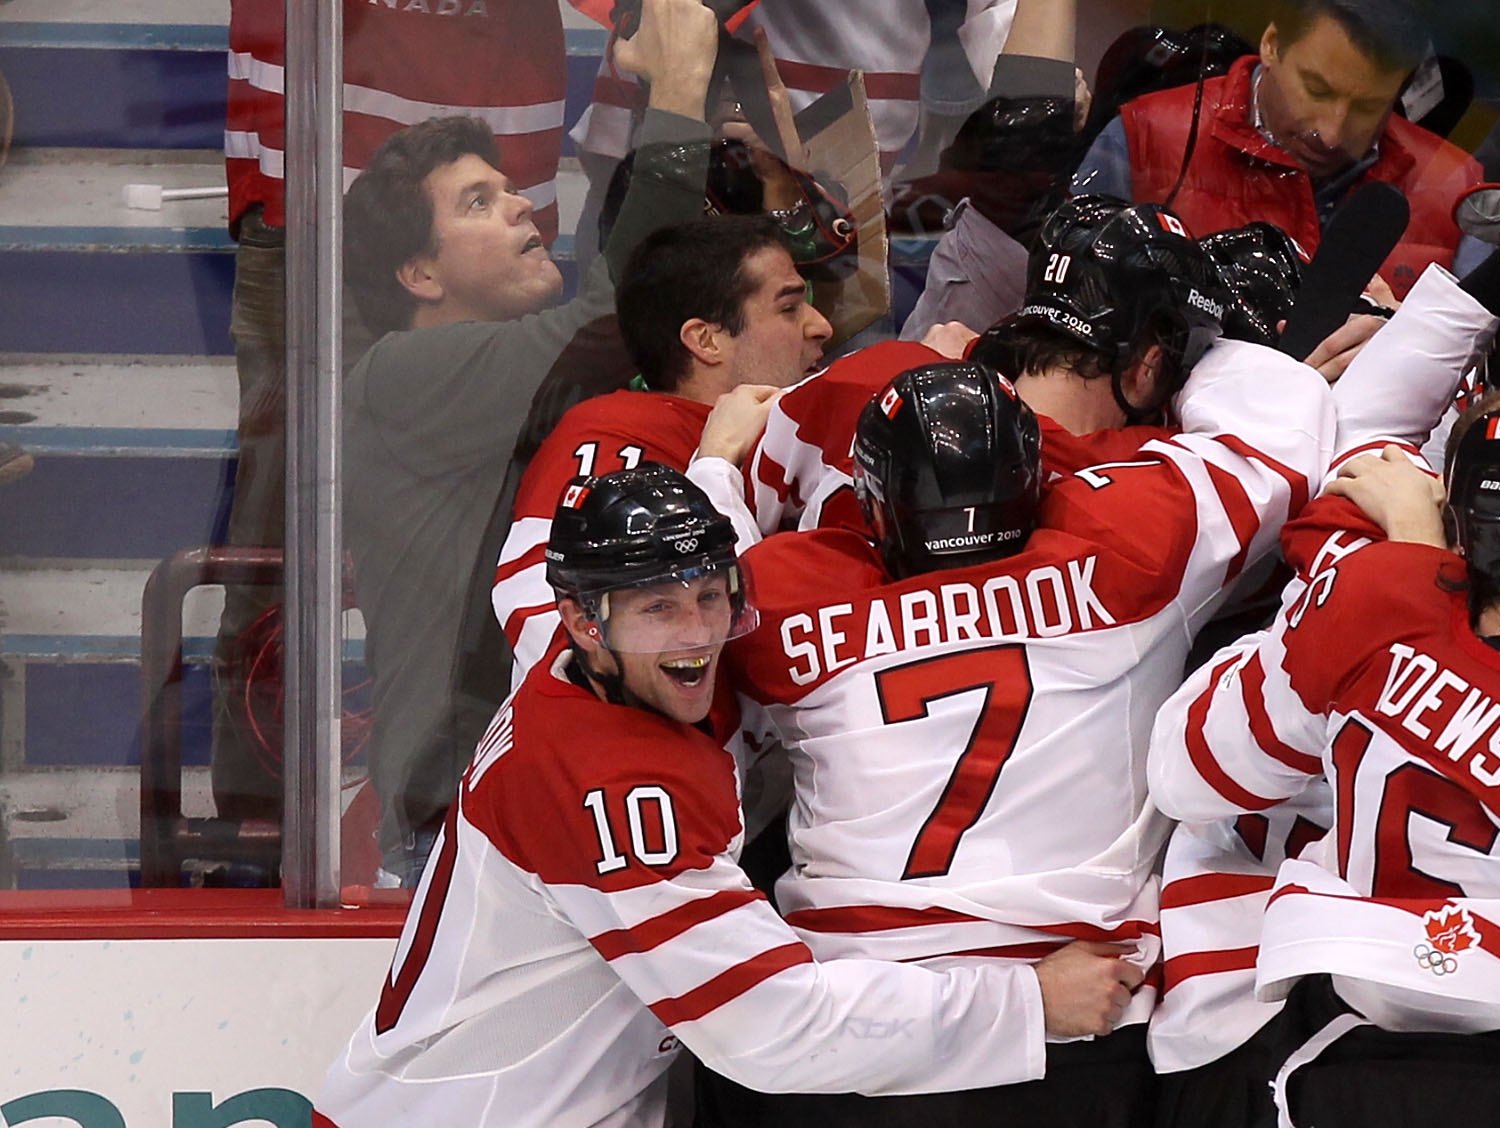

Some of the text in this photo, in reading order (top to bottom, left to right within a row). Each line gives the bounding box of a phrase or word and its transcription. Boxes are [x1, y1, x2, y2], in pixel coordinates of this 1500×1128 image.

[1043, 253, 1072, 284] 20
[1187, 287, 1225, 321] Reebok
[1062, 311, 1095, 335] 2010
[962, 506, 976, 533] 7
[924, 528, 1023, 551] vancouver 2010
[779, 554, 1117, 687] SEABROOK
[873, 641, 1035, 882] 7
[582, 784, 680, 877] 10
